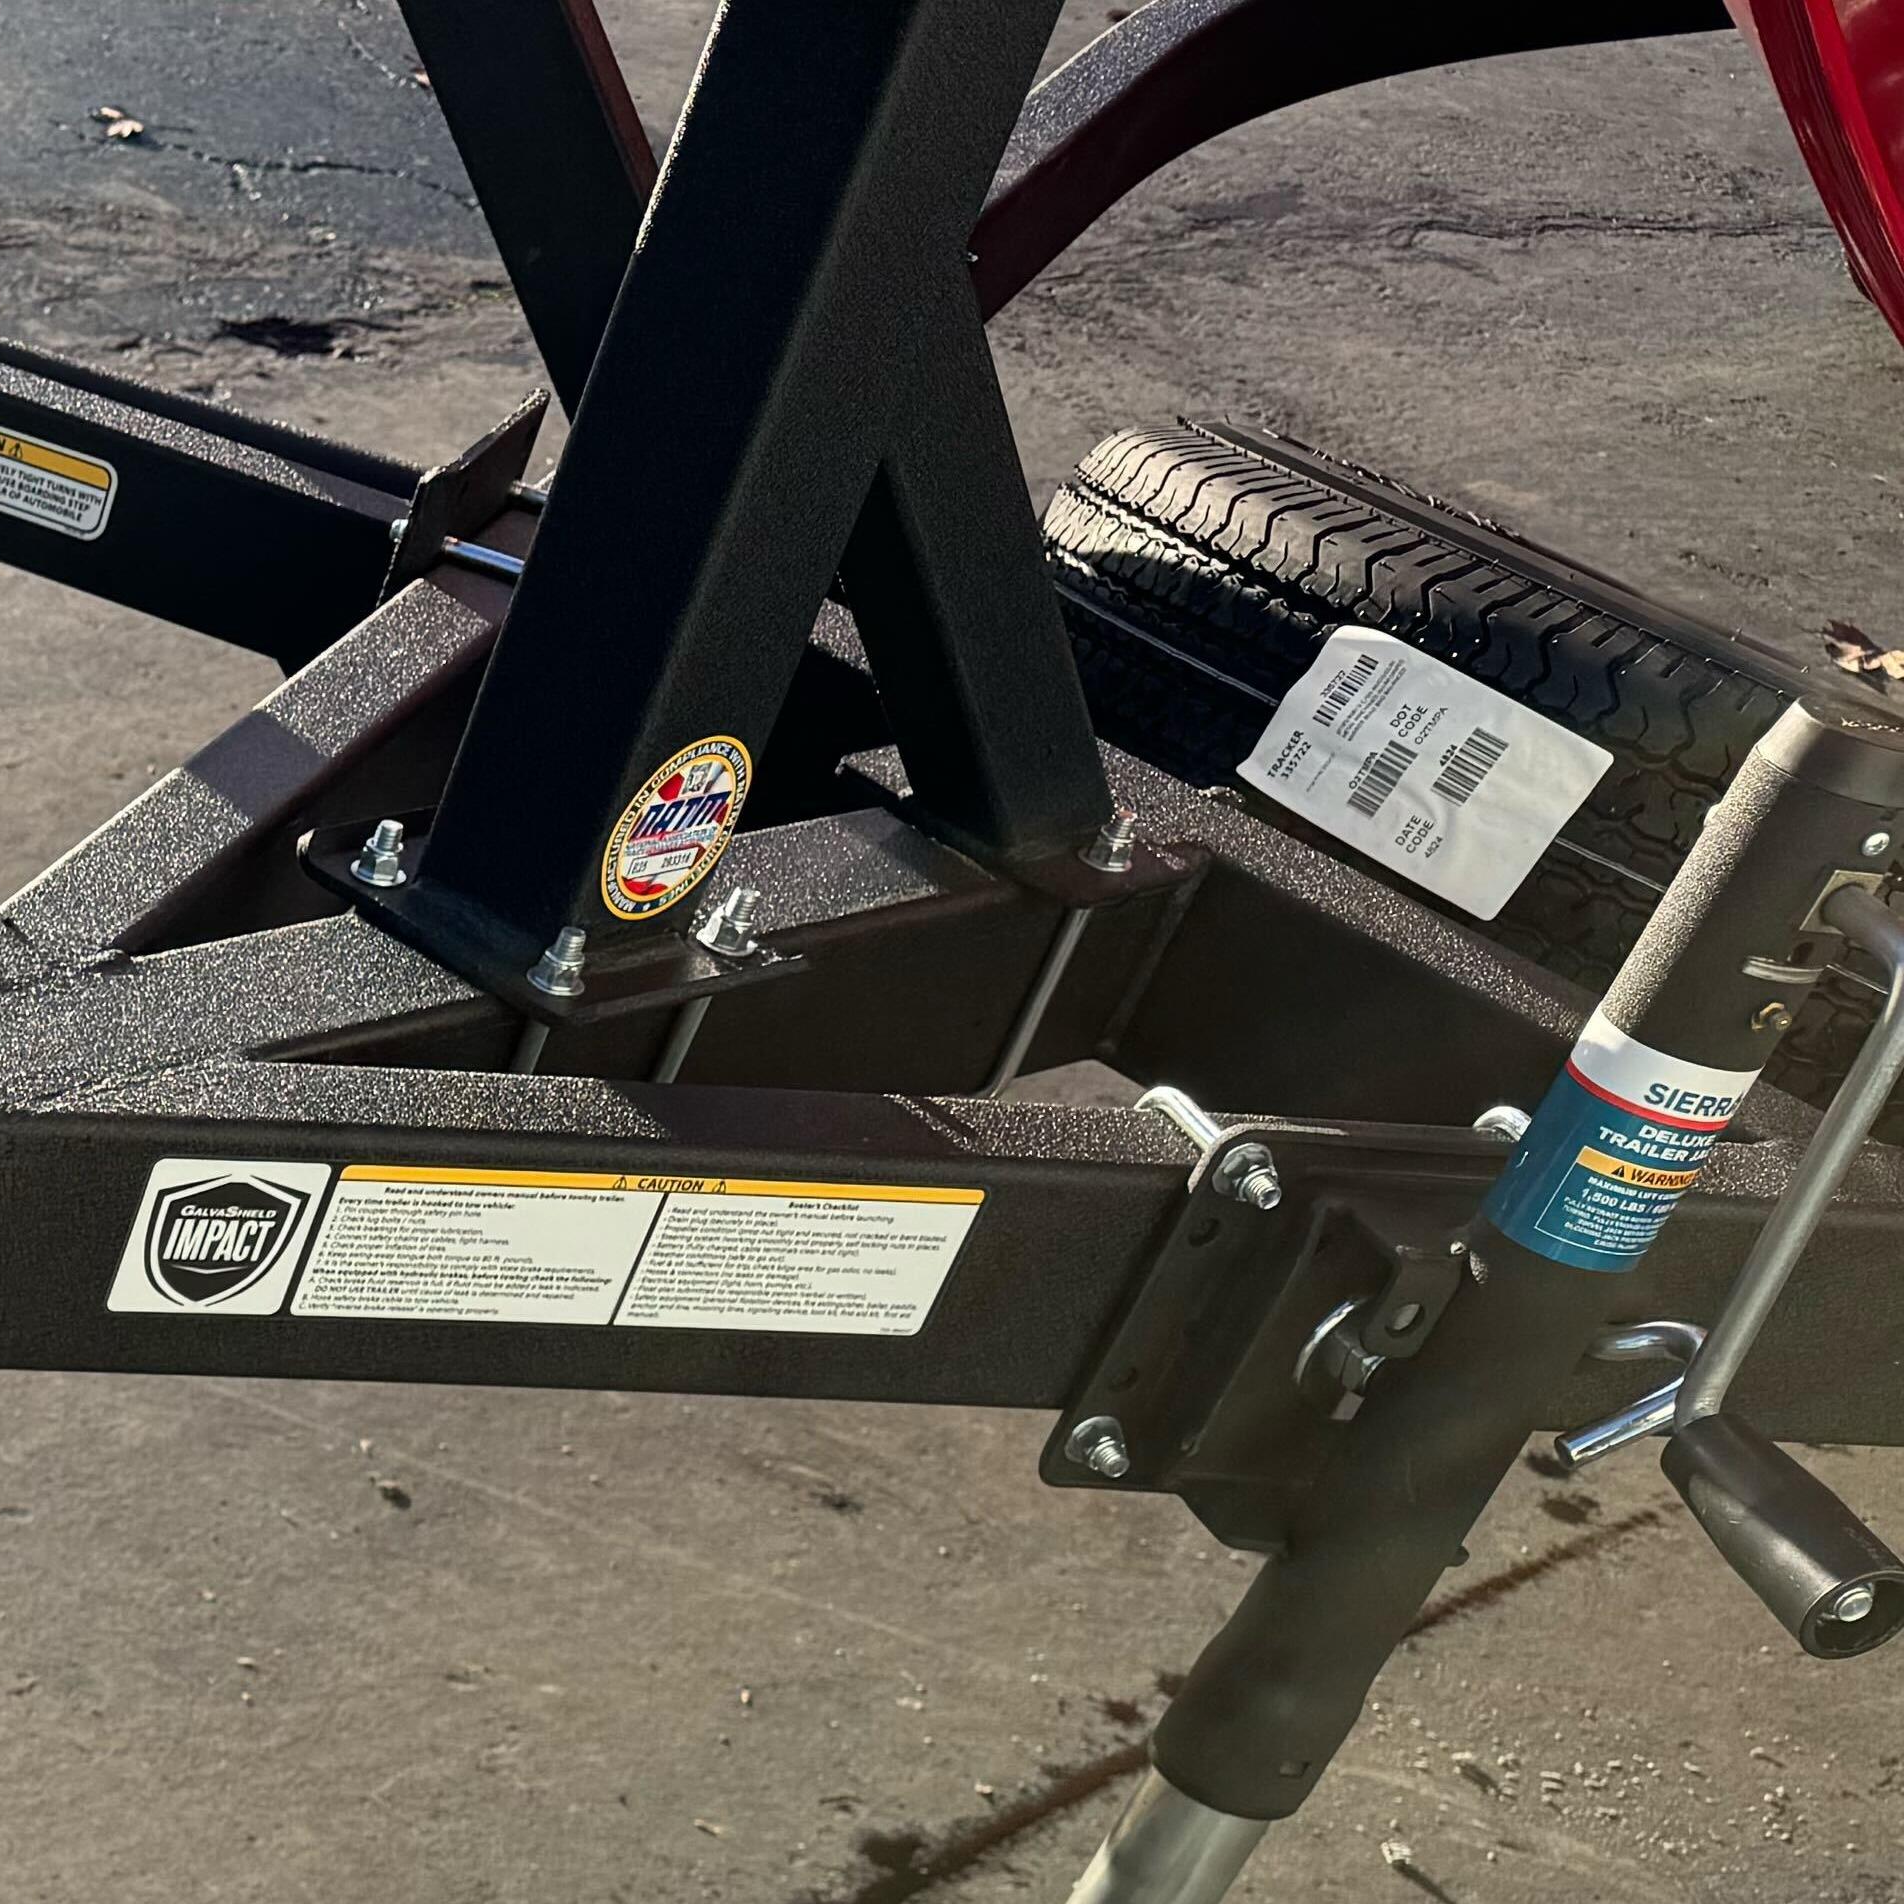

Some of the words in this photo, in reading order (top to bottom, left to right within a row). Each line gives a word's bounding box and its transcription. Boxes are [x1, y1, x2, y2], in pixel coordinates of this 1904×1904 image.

[18, 470, 45, 486] TIGHT
[46, 479, 75, 496] TURNS
[78, 491, 101, 505] WITH
[18, 481, 66, 504] BOARDING
[68, 498, 89, 512] STEP
[22, 494, 81, 521] AUTOMOBILE
[1390, 704, 1412, 728] DOT
[1398, 706, 1428, 738] CODE
[1267, 730, 1304, 778] TRACKER
[1281, 741, 1312, 779] 335722
[1395, 815, 1422, 846] DATE
[1406, 819, 1434, 854] CODE
[1599, 1126, 1688, 1162] TRAILER
[1638, 1124, 1716, 1147] DELUXE
[637, 1178, 705, 1193] CAUTION
[1582, 1188, 1618, 1207] 1,500
[1619, 1200, 1646, 1213] LBS
[162, 1218, 276, 1261] IMPACT
